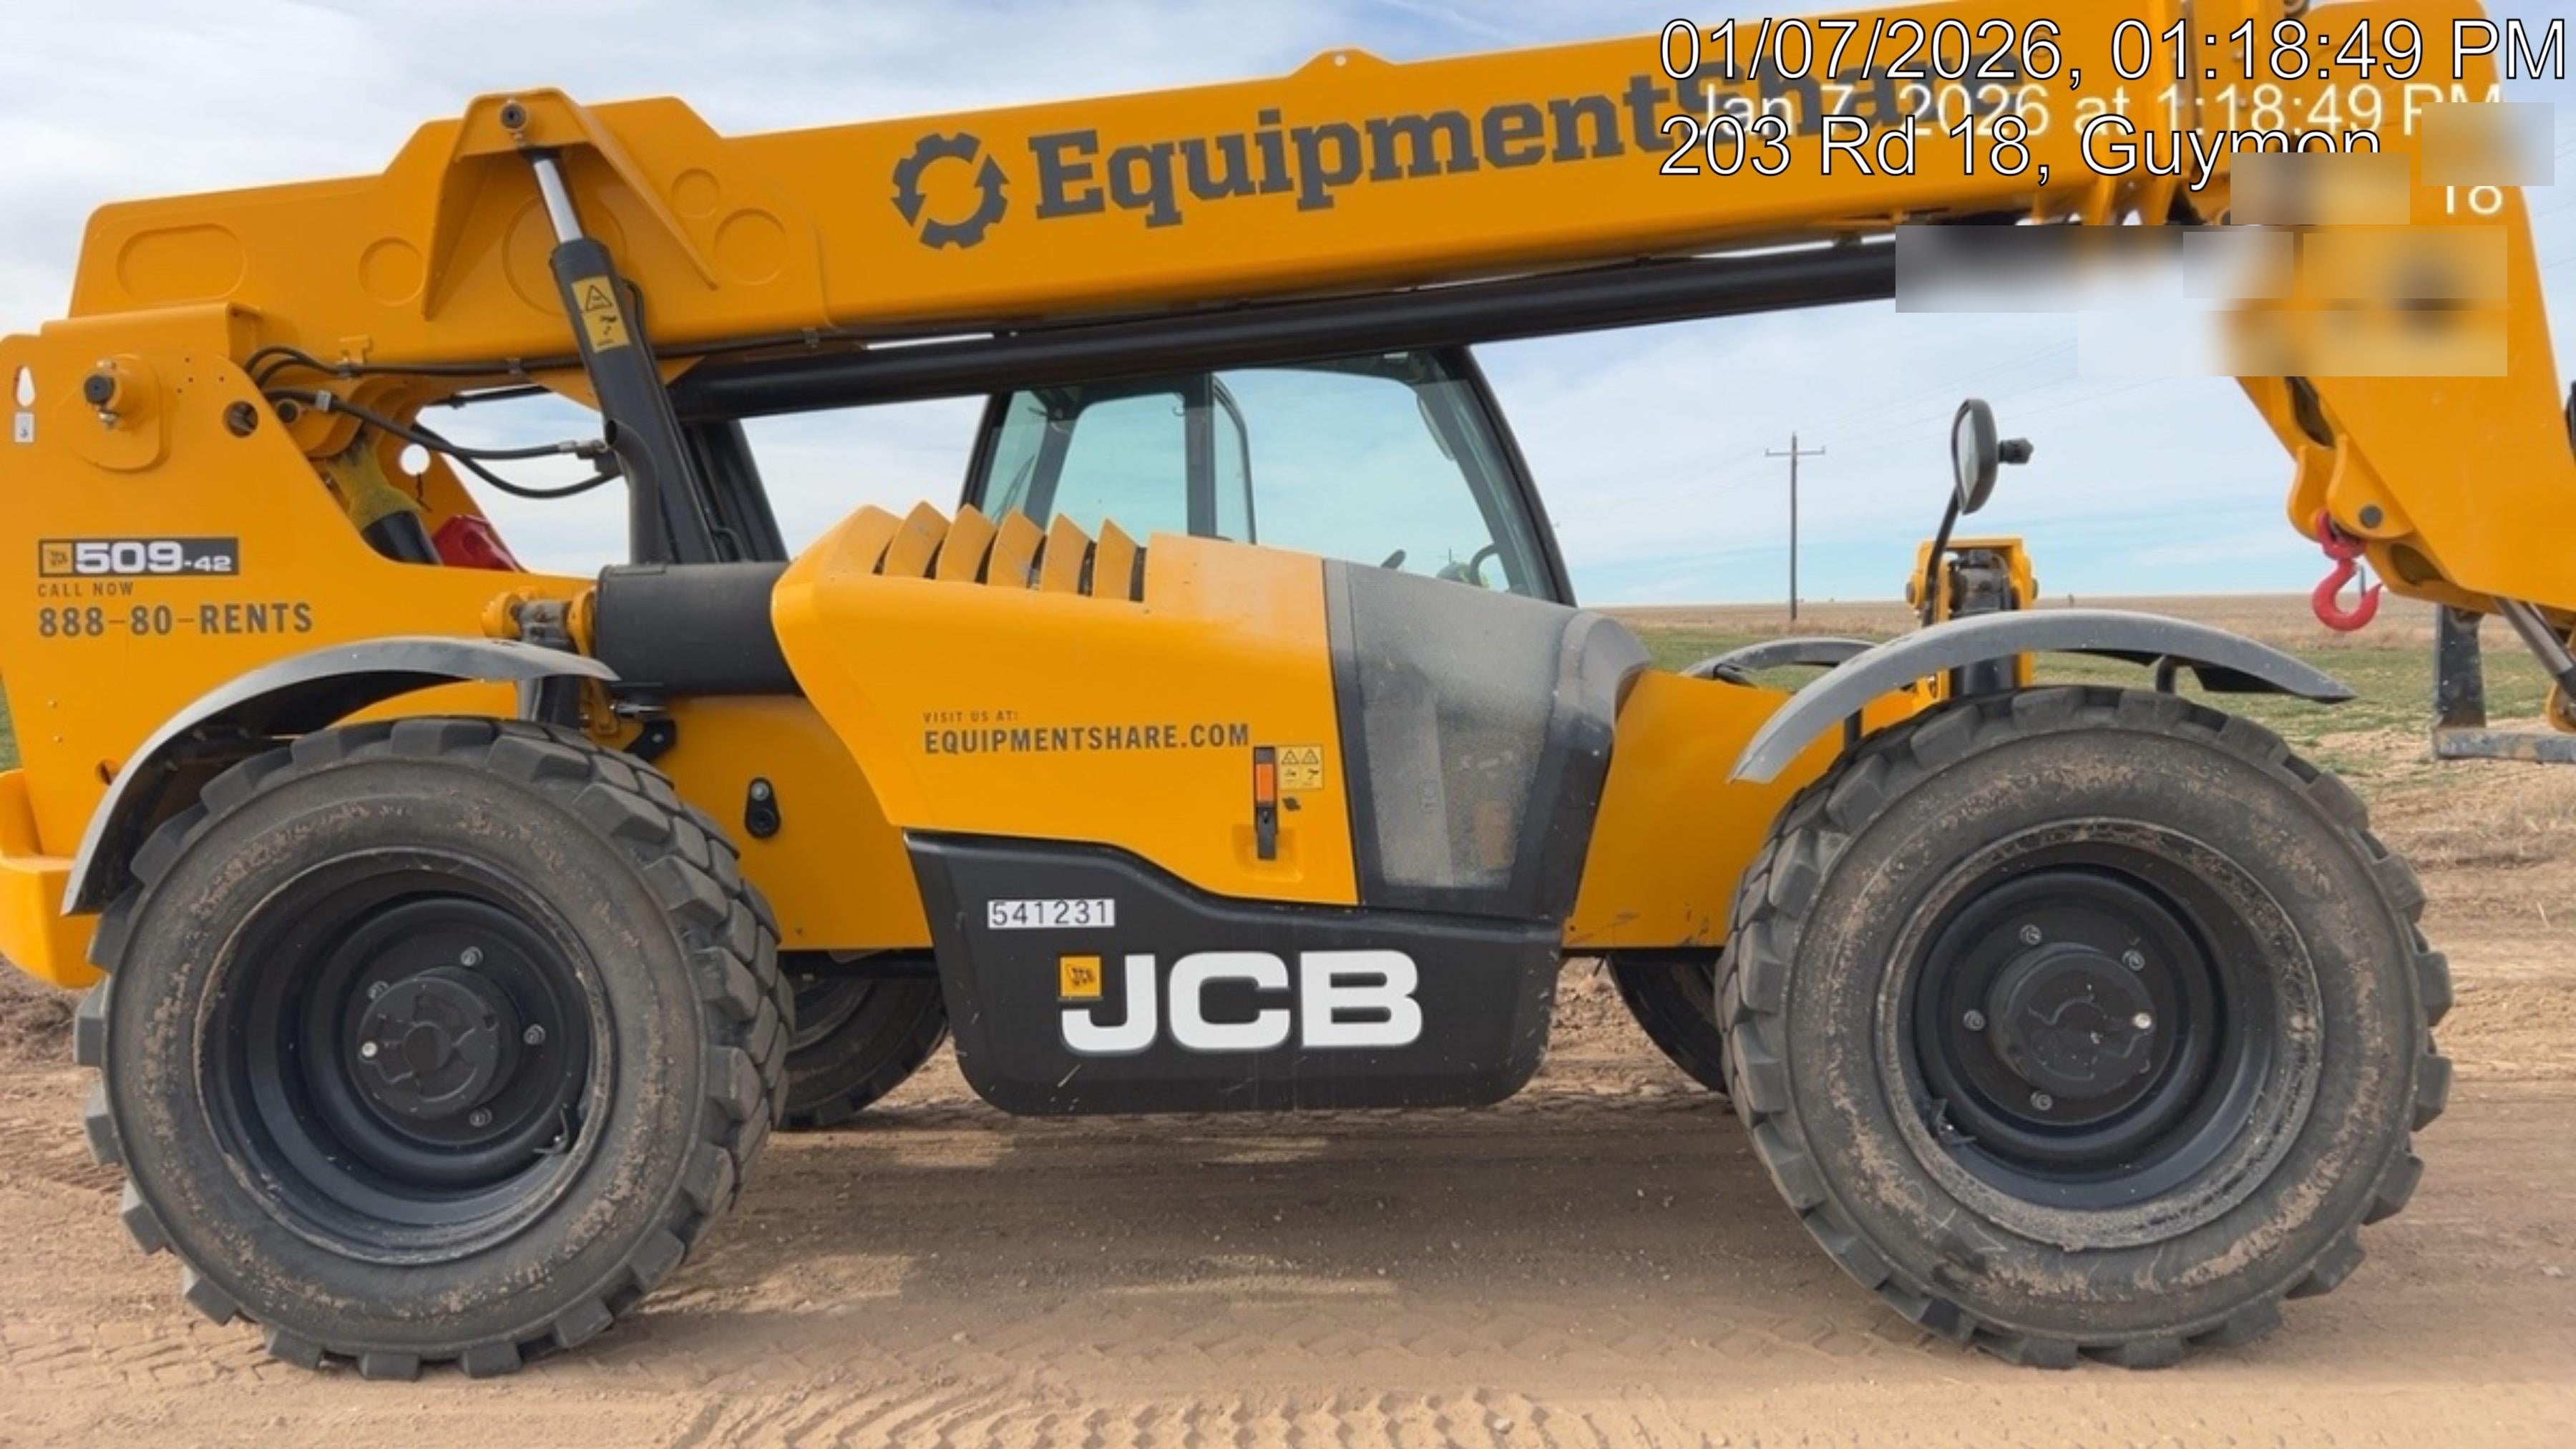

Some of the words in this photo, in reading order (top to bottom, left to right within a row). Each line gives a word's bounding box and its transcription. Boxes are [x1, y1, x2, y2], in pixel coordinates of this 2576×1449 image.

[37, 583, 83, 597] CALL
[92, 580, 134, 597] NOW
[39, 602, 313, 638] 888-80-RENTS
[923, 711, 963, 723] VISIT
[970, 711, 989, 722] US
[995, 709, 1019, 721] AT:
[924, 723, 1250, 755] EQUIPMENTSHARE.COM
[992, 899, 1106, 926] 541231
[1061, 950, 1423, 1054] JCB
